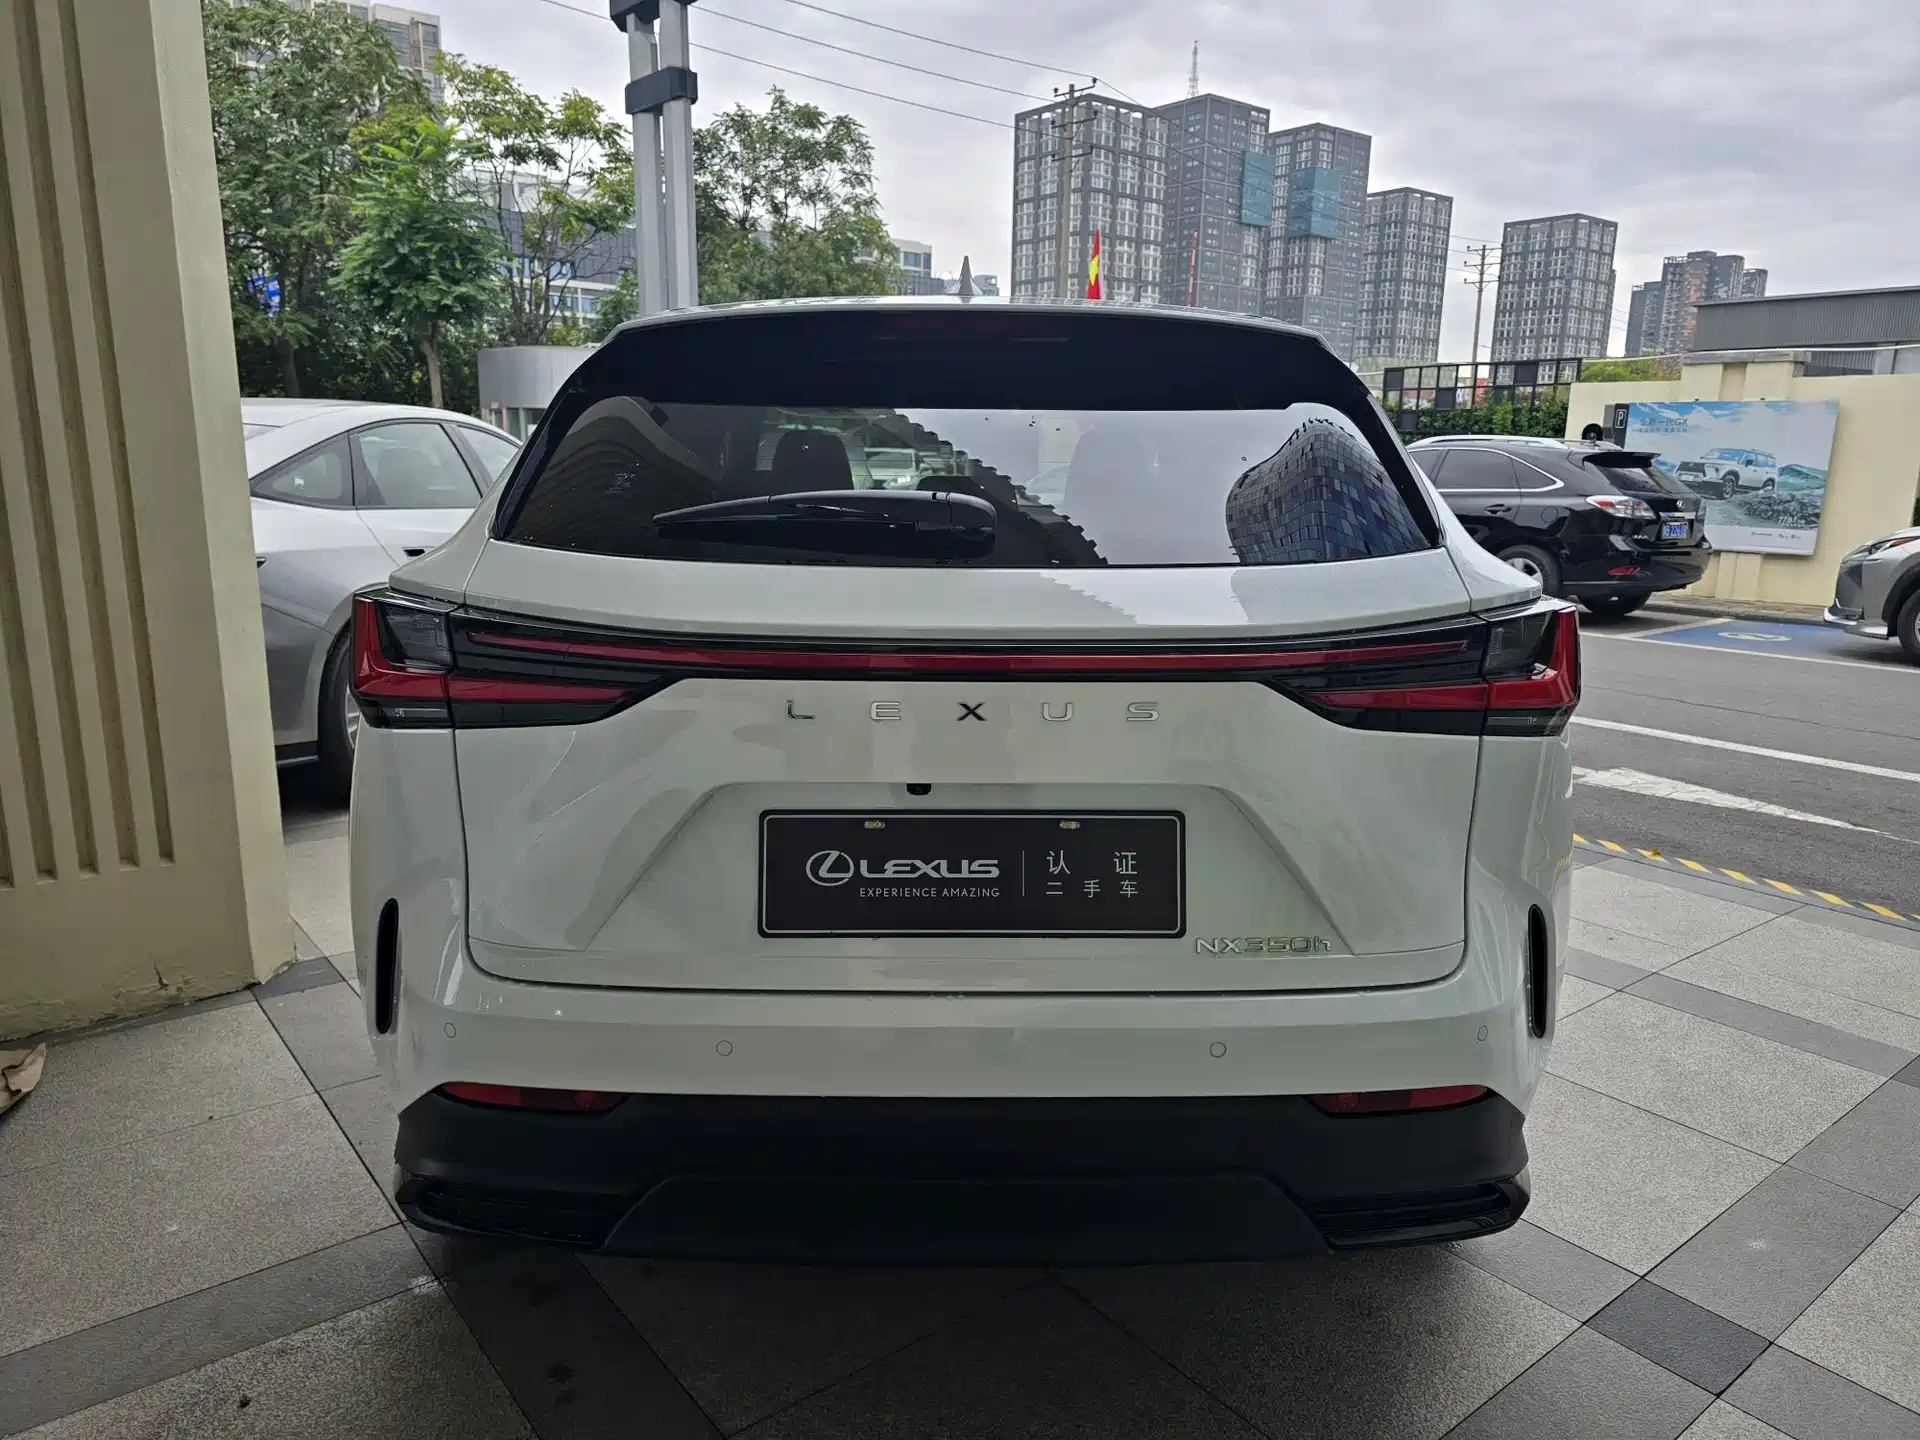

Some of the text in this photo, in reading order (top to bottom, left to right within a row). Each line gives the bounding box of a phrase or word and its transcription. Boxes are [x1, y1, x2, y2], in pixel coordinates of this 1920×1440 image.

[786, 700, 1161, 723] LEXUS
[860, 859, 1000, 878] LEXUS
[859, 887, 1000, 898] EXPERIENCE AMAZING
[1046, 879, 1139, 898] 二手车
[1196, 936, 1331, 954] NX350h
